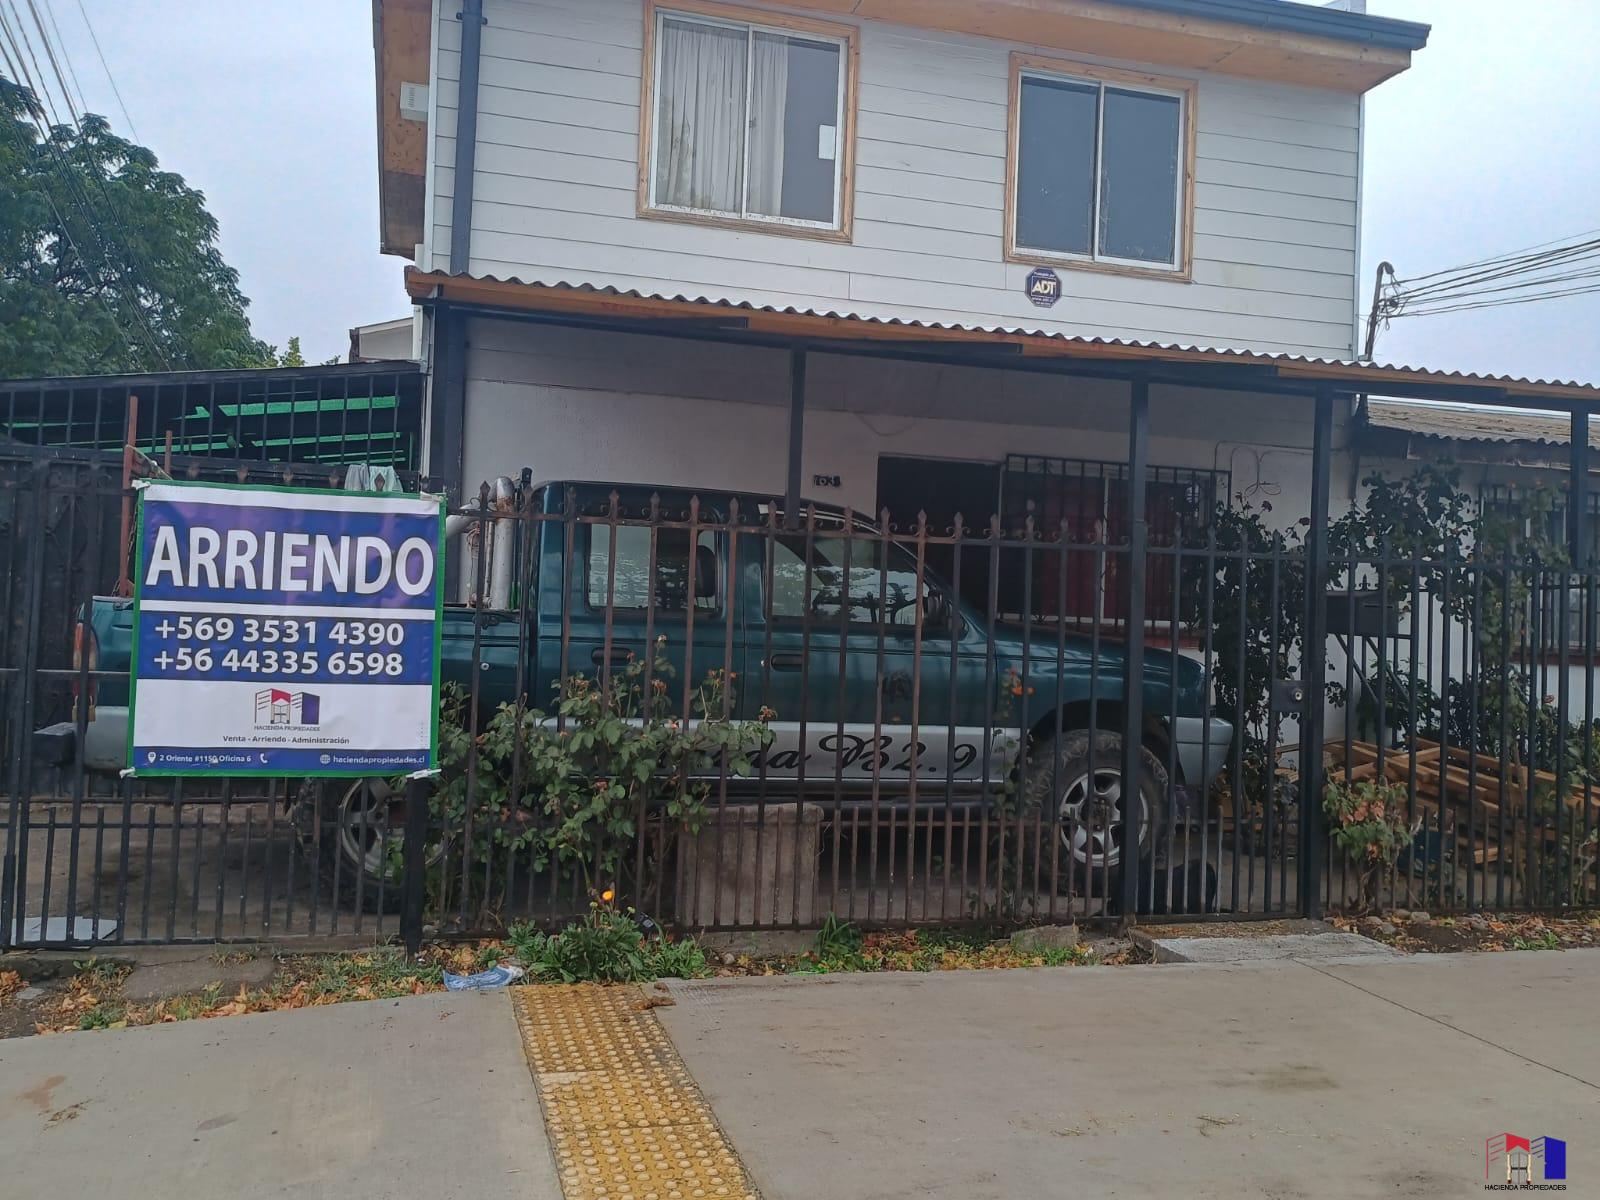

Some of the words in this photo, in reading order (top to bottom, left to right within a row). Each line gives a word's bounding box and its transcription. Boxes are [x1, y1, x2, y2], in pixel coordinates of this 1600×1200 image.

[1032, 280, 1056, 294] ADT
[145, 525, 434, 596] ARRIENDO
[155, 616, 234, 641] +569
[242, 618, 316, 644] 3531
[328, 621, 404, 646] 4390
[154, 647, 213, 672] +56
[221, 649, 318, 674] 44335
[327, 651, 403, 676] 6598
[252, 735, 287, 743] Arriendo
[291, 736, 350, 745] Administración
[166, 754, 193, 762] Oriente
[219, 754, 245, 762] Oficina
[333, 755, 425, 765] haciendapropiedades.cl
